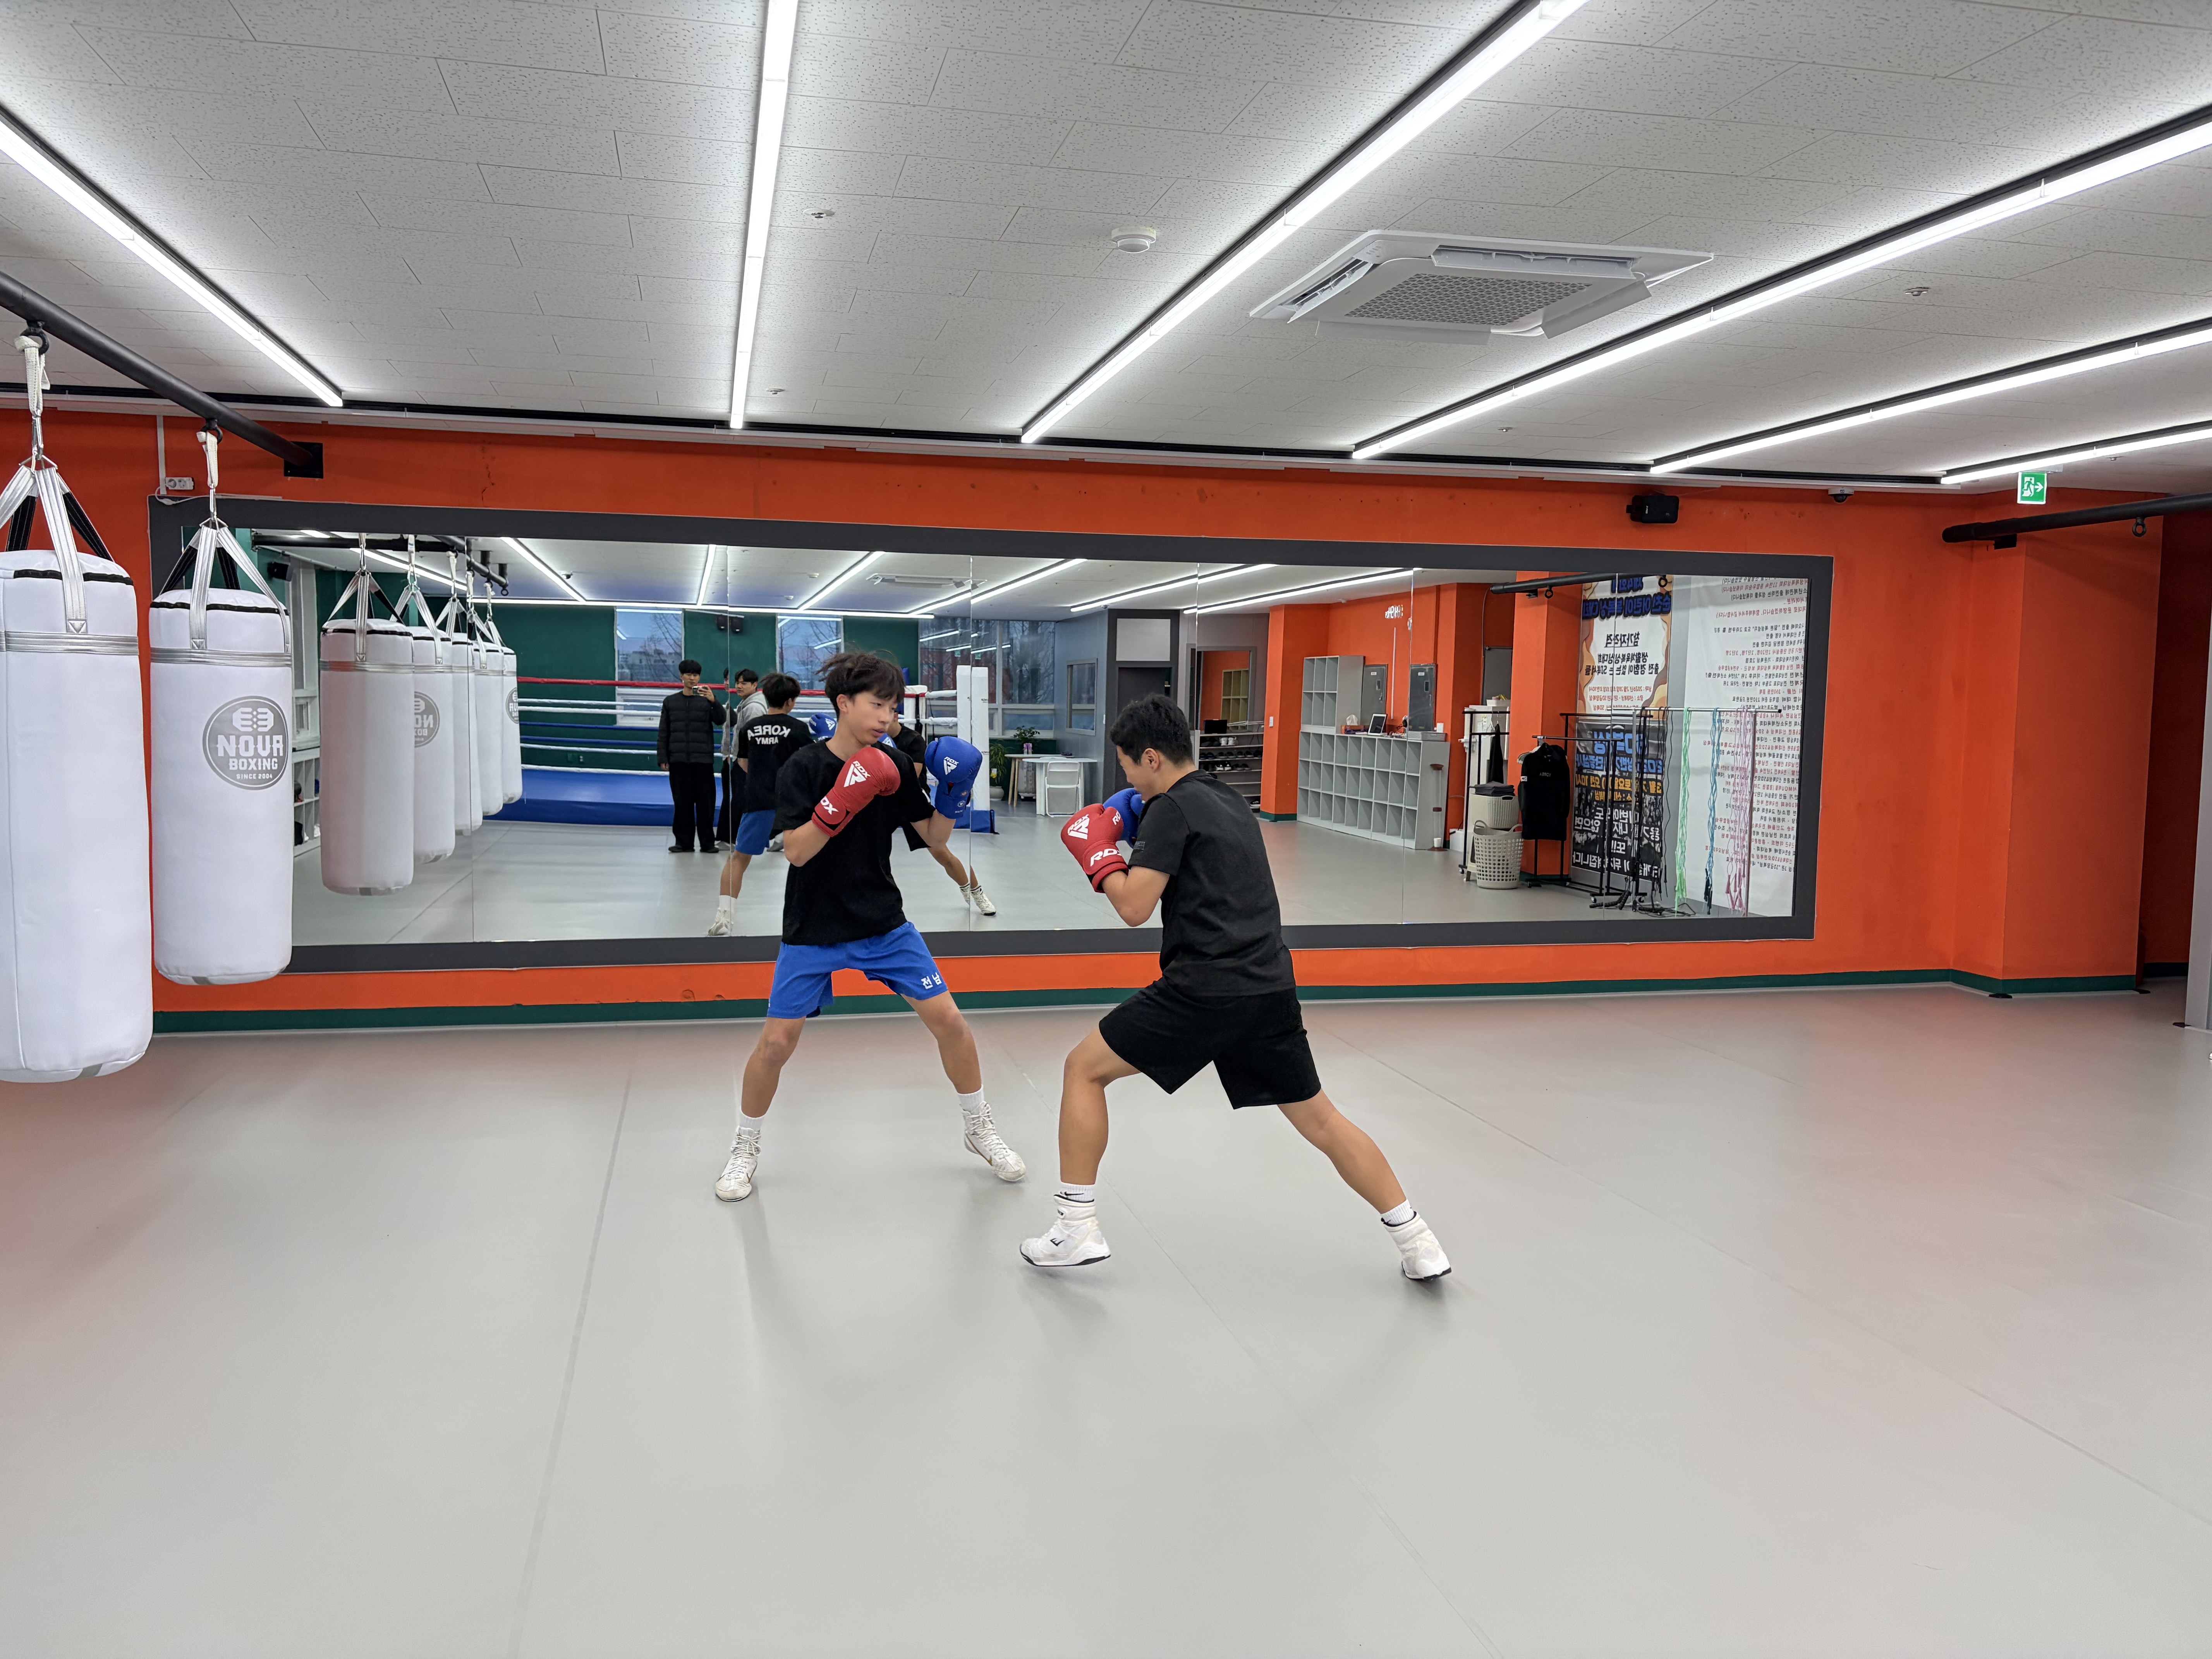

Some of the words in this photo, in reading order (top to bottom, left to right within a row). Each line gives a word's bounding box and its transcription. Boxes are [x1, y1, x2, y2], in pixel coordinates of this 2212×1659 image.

[229, 758, 278, 770] BOXING
[944, 756, 959, 766] RDX
[853, 760, 871, 778] RDX
[1067, 814, 1089, 835] RDX
